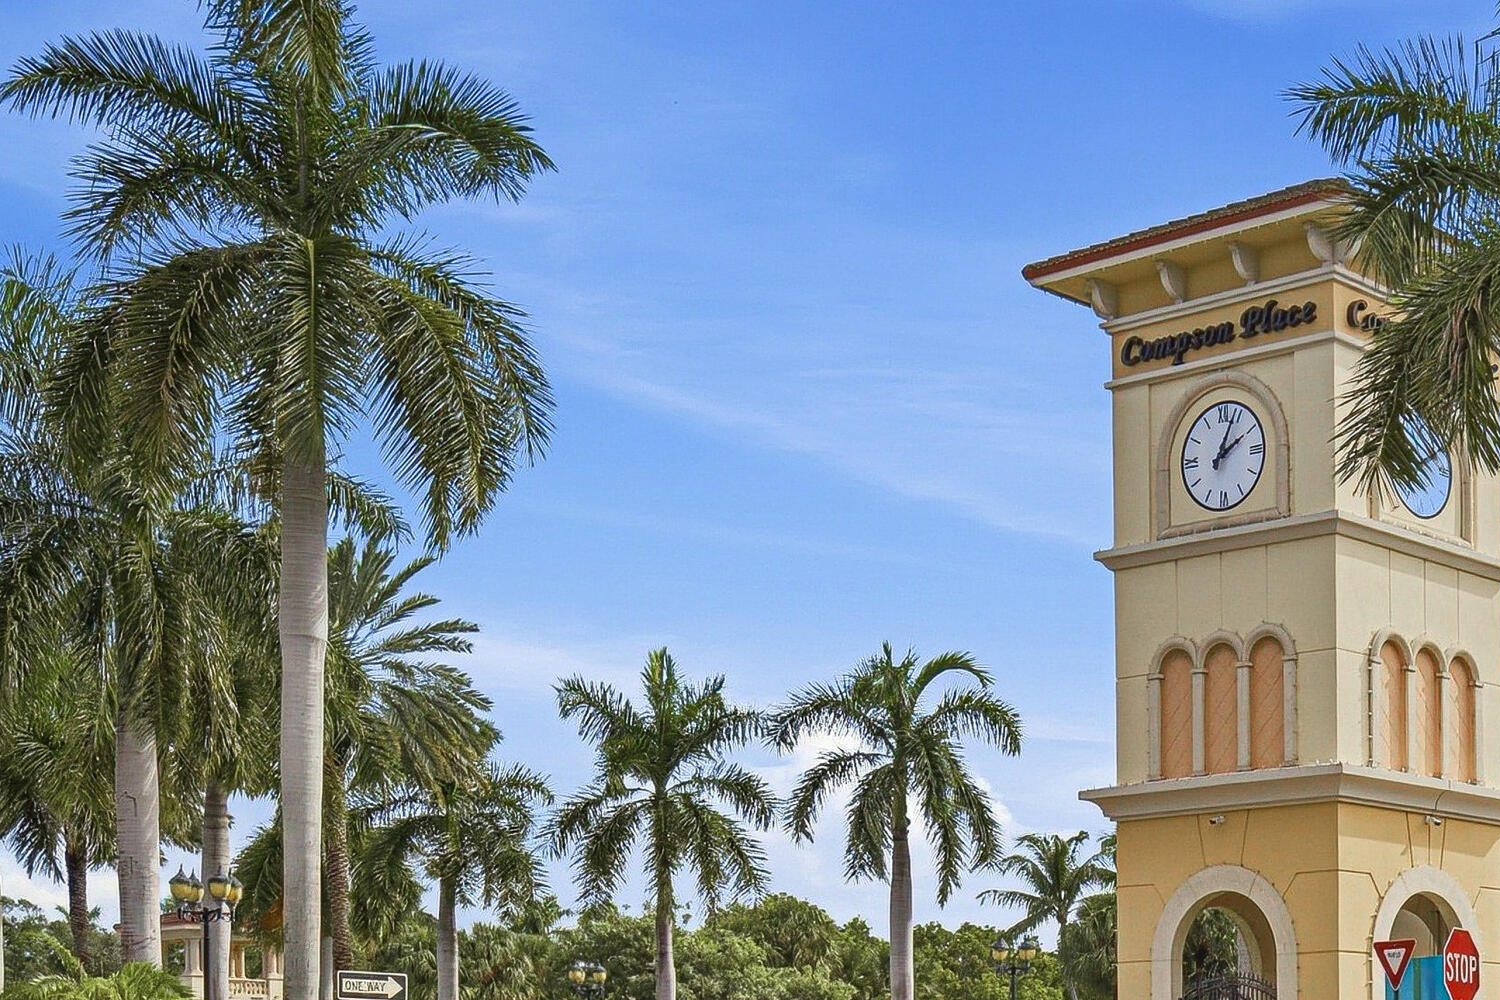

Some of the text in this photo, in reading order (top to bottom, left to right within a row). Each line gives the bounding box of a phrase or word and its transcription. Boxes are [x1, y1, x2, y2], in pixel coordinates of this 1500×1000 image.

[1120, 320, 1236, 366] Compson
[1238, 299, 1318, 340] Place
[1445, 952, 1478, 984] STOP
[344, 980, 387, 993] ONE WAY
